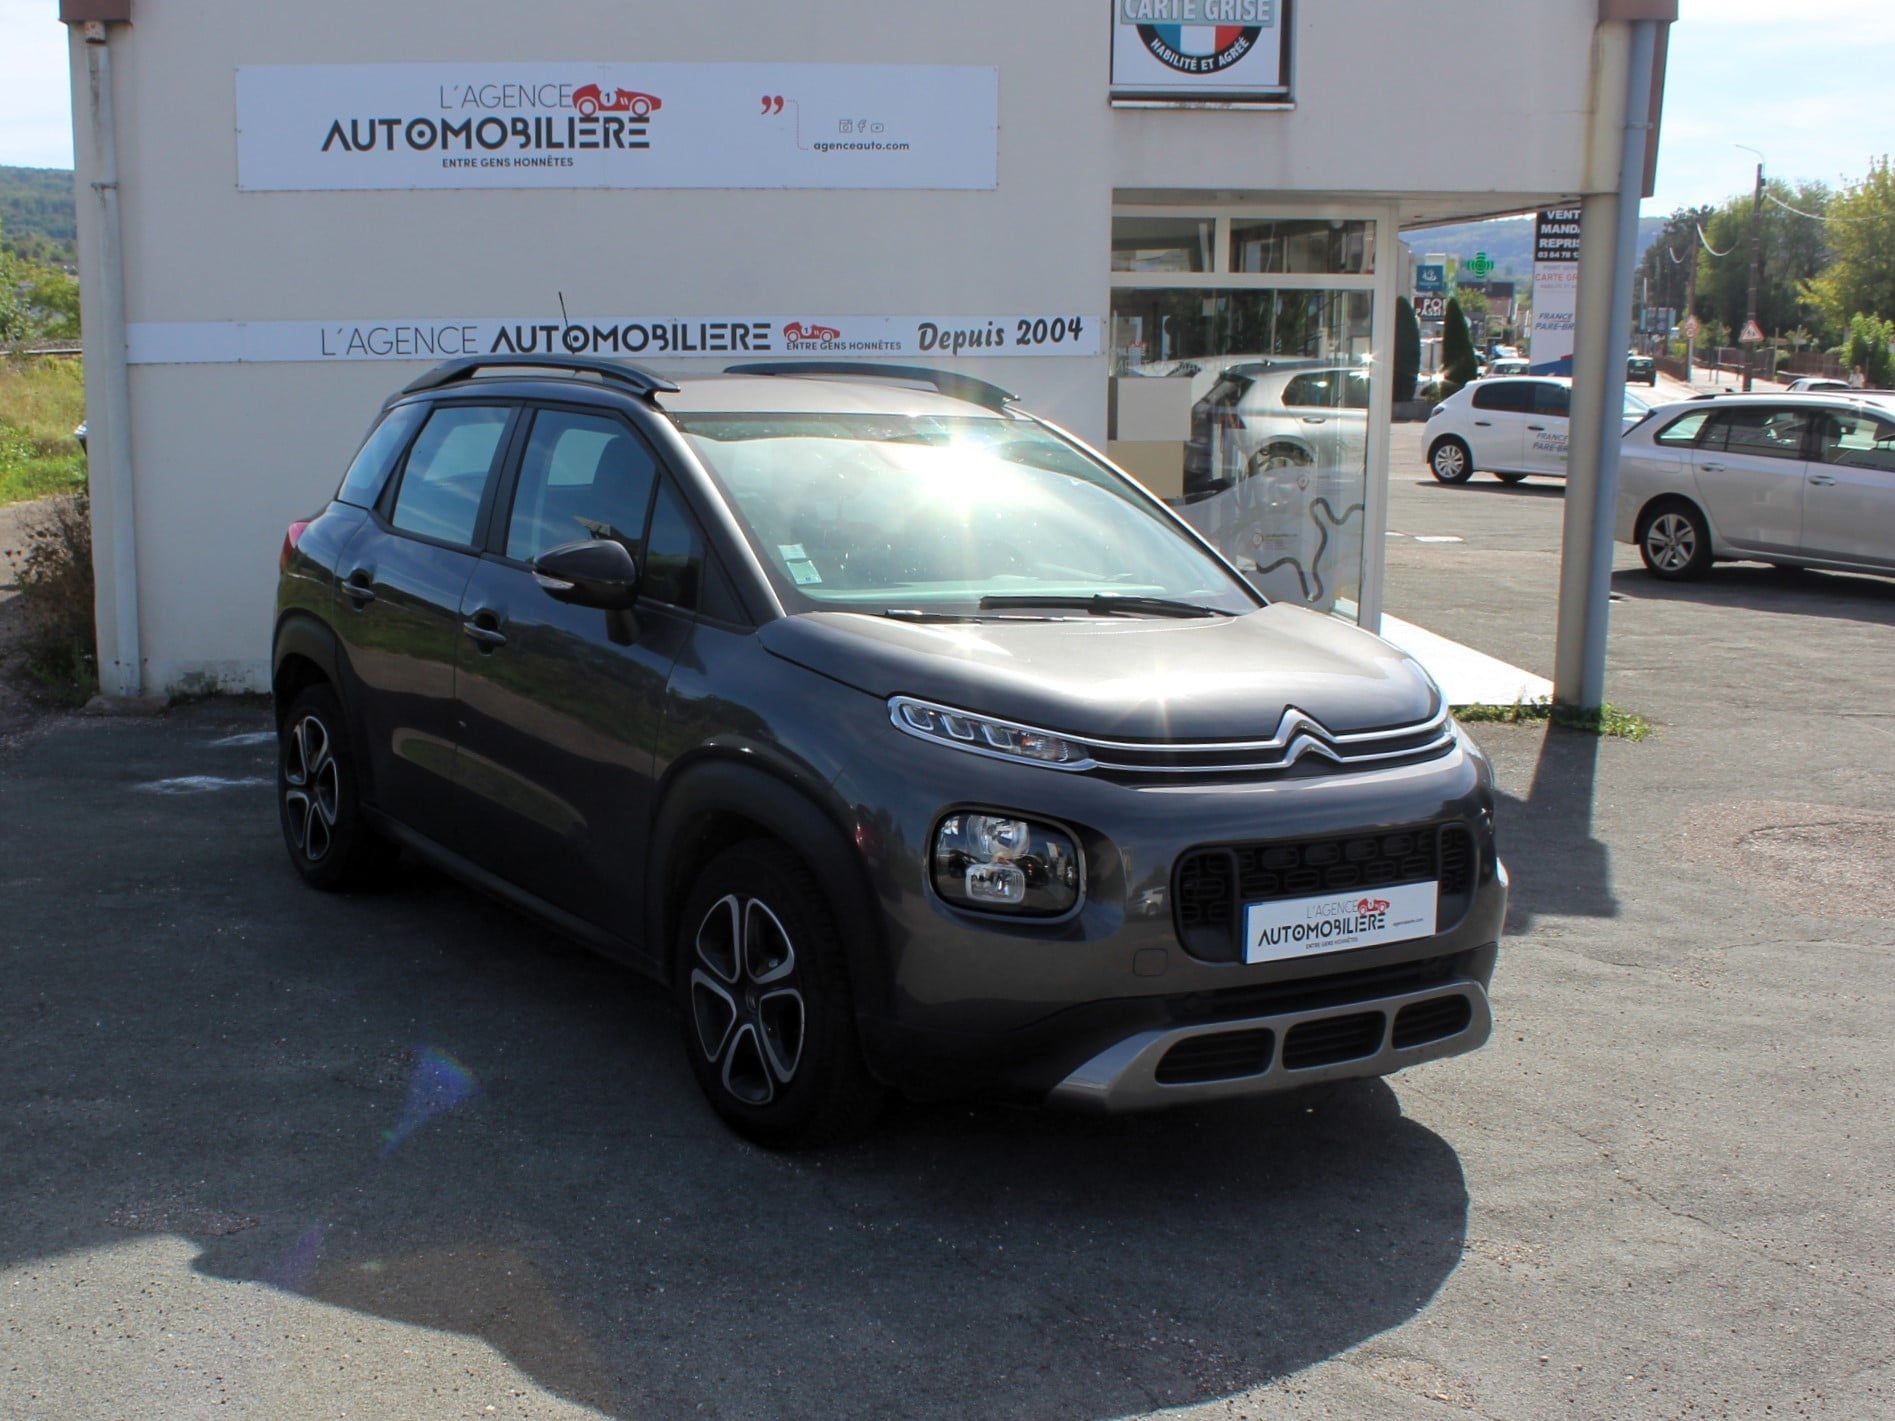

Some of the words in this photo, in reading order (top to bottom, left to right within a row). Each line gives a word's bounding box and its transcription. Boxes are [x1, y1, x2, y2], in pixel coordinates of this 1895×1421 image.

[1123, 0, 1196, 20] CARTE
[1204, 0, 1271, 22] GRISE
[1151, 37, 1198, 71] HABILITÉ
[1201, 57, 1214, 71] ET
[440, 84, 573, 109] L'AGENCE
[813, 141, 910, 152] agenceauto.com
[442, 158, 478, 168] ENTRE
[480, 158, 511, 168] GENS
[514, 155, 574, 168] HONNÊTES
[321, 326, 479, 356] L'AGENCE
[786, 341, 817, 351] ENTRE
[819, 341, 847, 351] GENS
[849, 338, 902, 351] HONNÊTES
[917, 321, 1005, 356] Depuis
[1015, 317, 1084, 345] 2004
[1306, 899, 1358, 919] L'AGENCE
